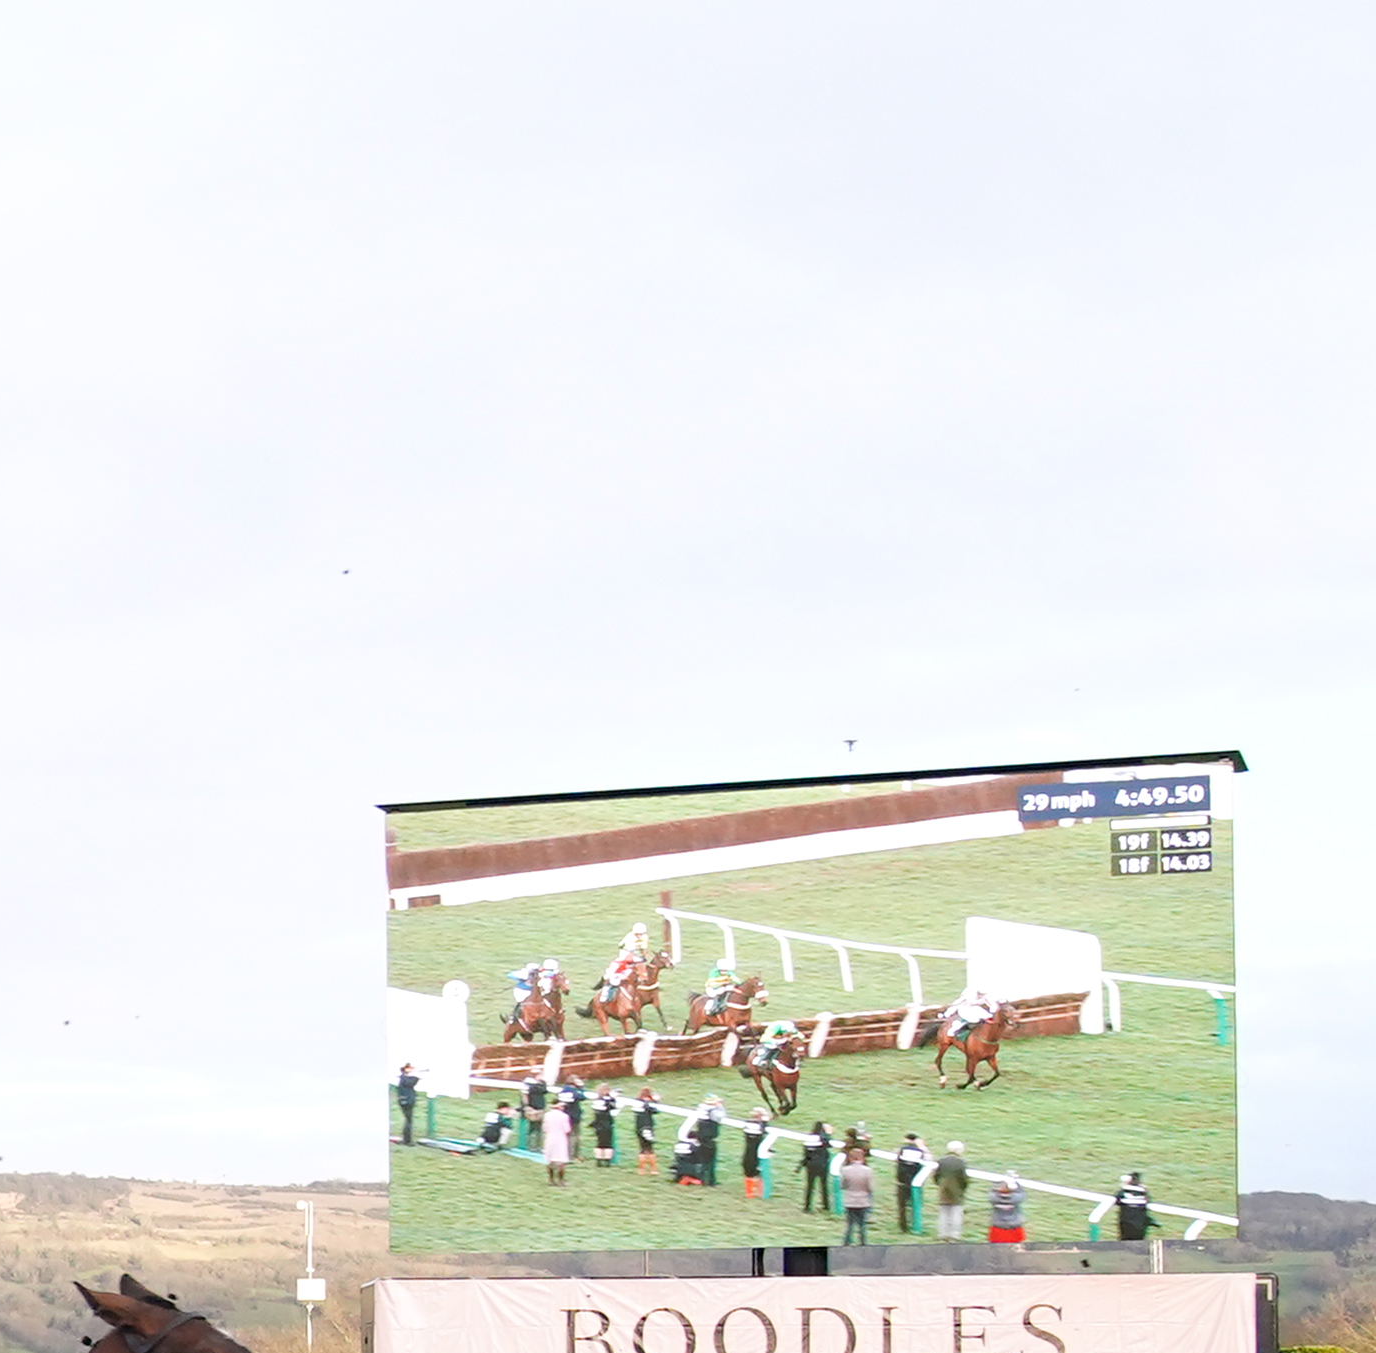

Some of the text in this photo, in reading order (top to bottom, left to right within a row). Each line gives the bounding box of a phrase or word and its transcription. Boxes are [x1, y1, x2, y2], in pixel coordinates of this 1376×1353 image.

[1023, 784, 1205, 812] 29 mph 4:49.50
[1118, 831, 1210, 850] 19f 14.39
[1119, 854, 1210, 873] 18f 14.03
